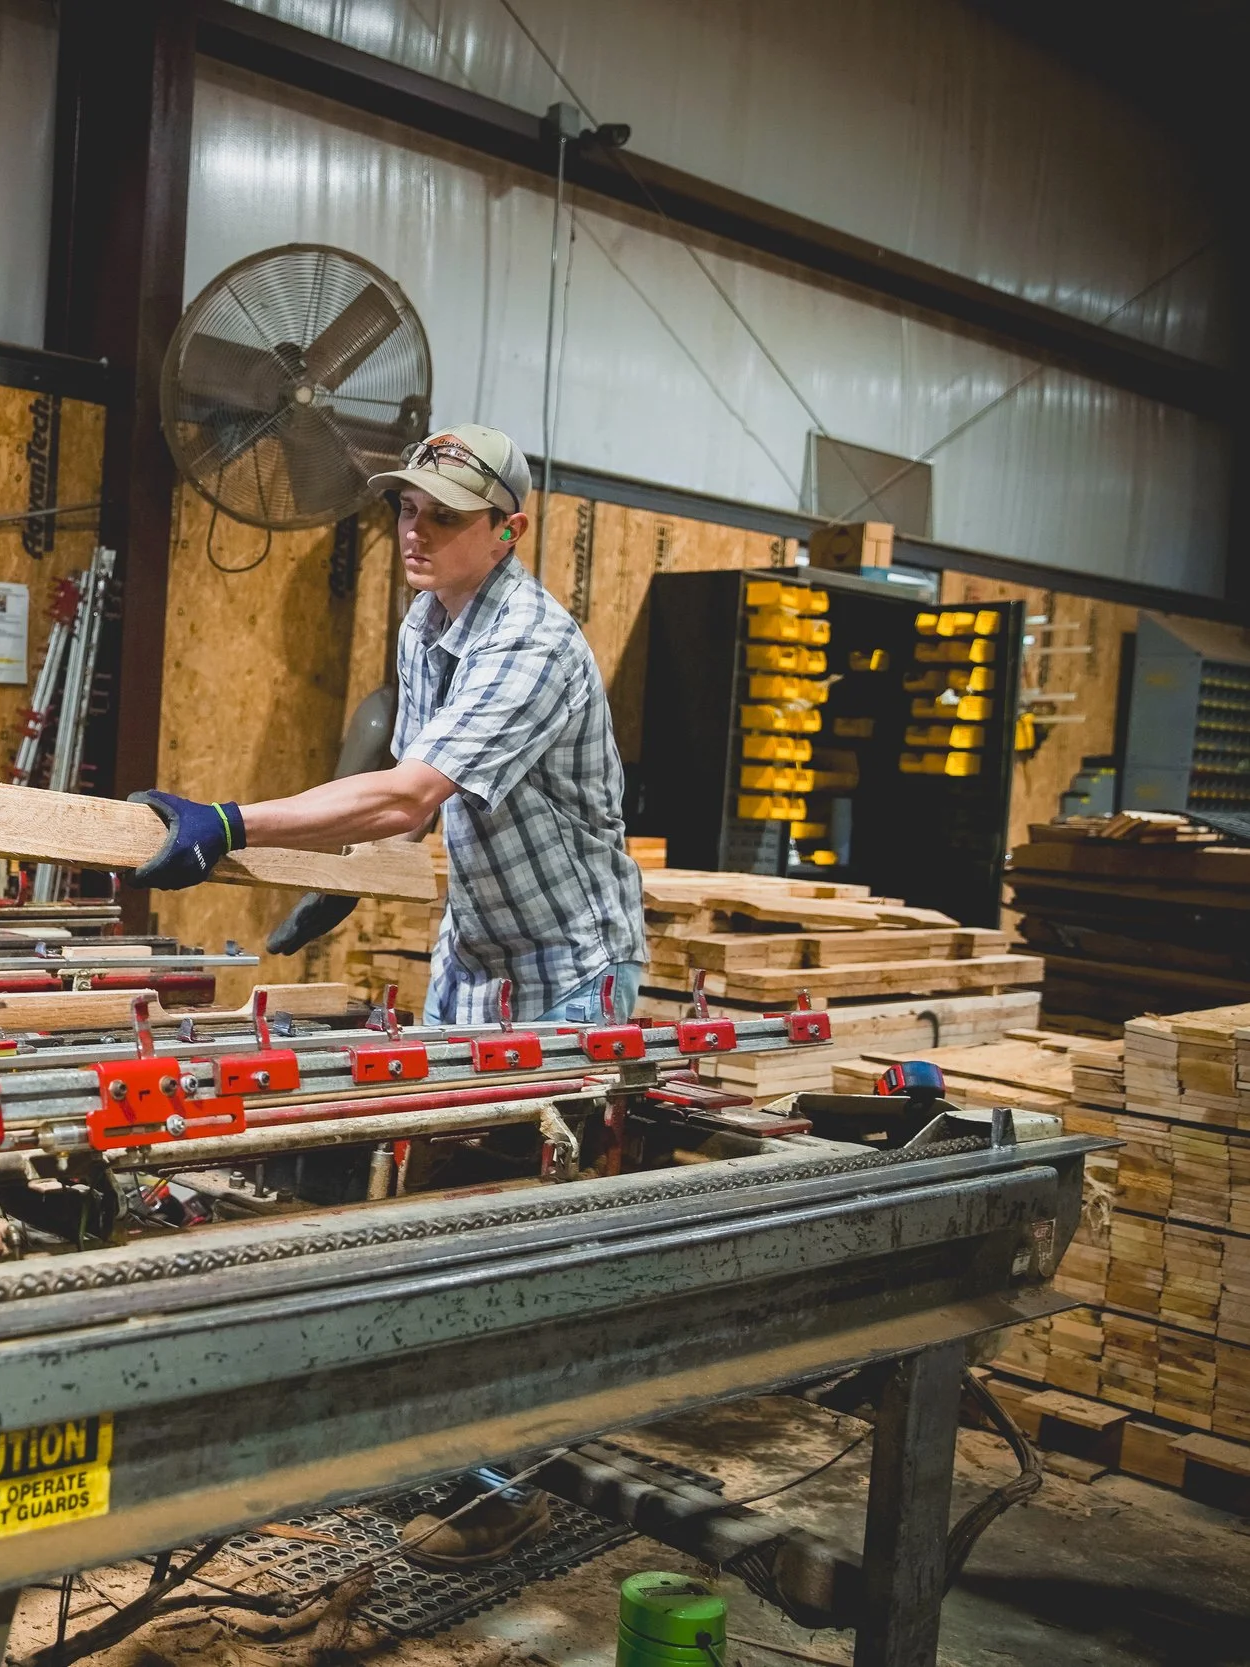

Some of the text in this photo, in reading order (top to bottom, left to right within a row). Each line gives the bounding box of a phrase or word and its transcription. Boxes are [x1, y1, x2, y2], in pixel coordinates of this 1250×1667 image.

[194, 844, 206, 869] ULINE
[7, 1472, 87, 1504] OPERATE
[16, 1491, 91, 1522] GUARDS
